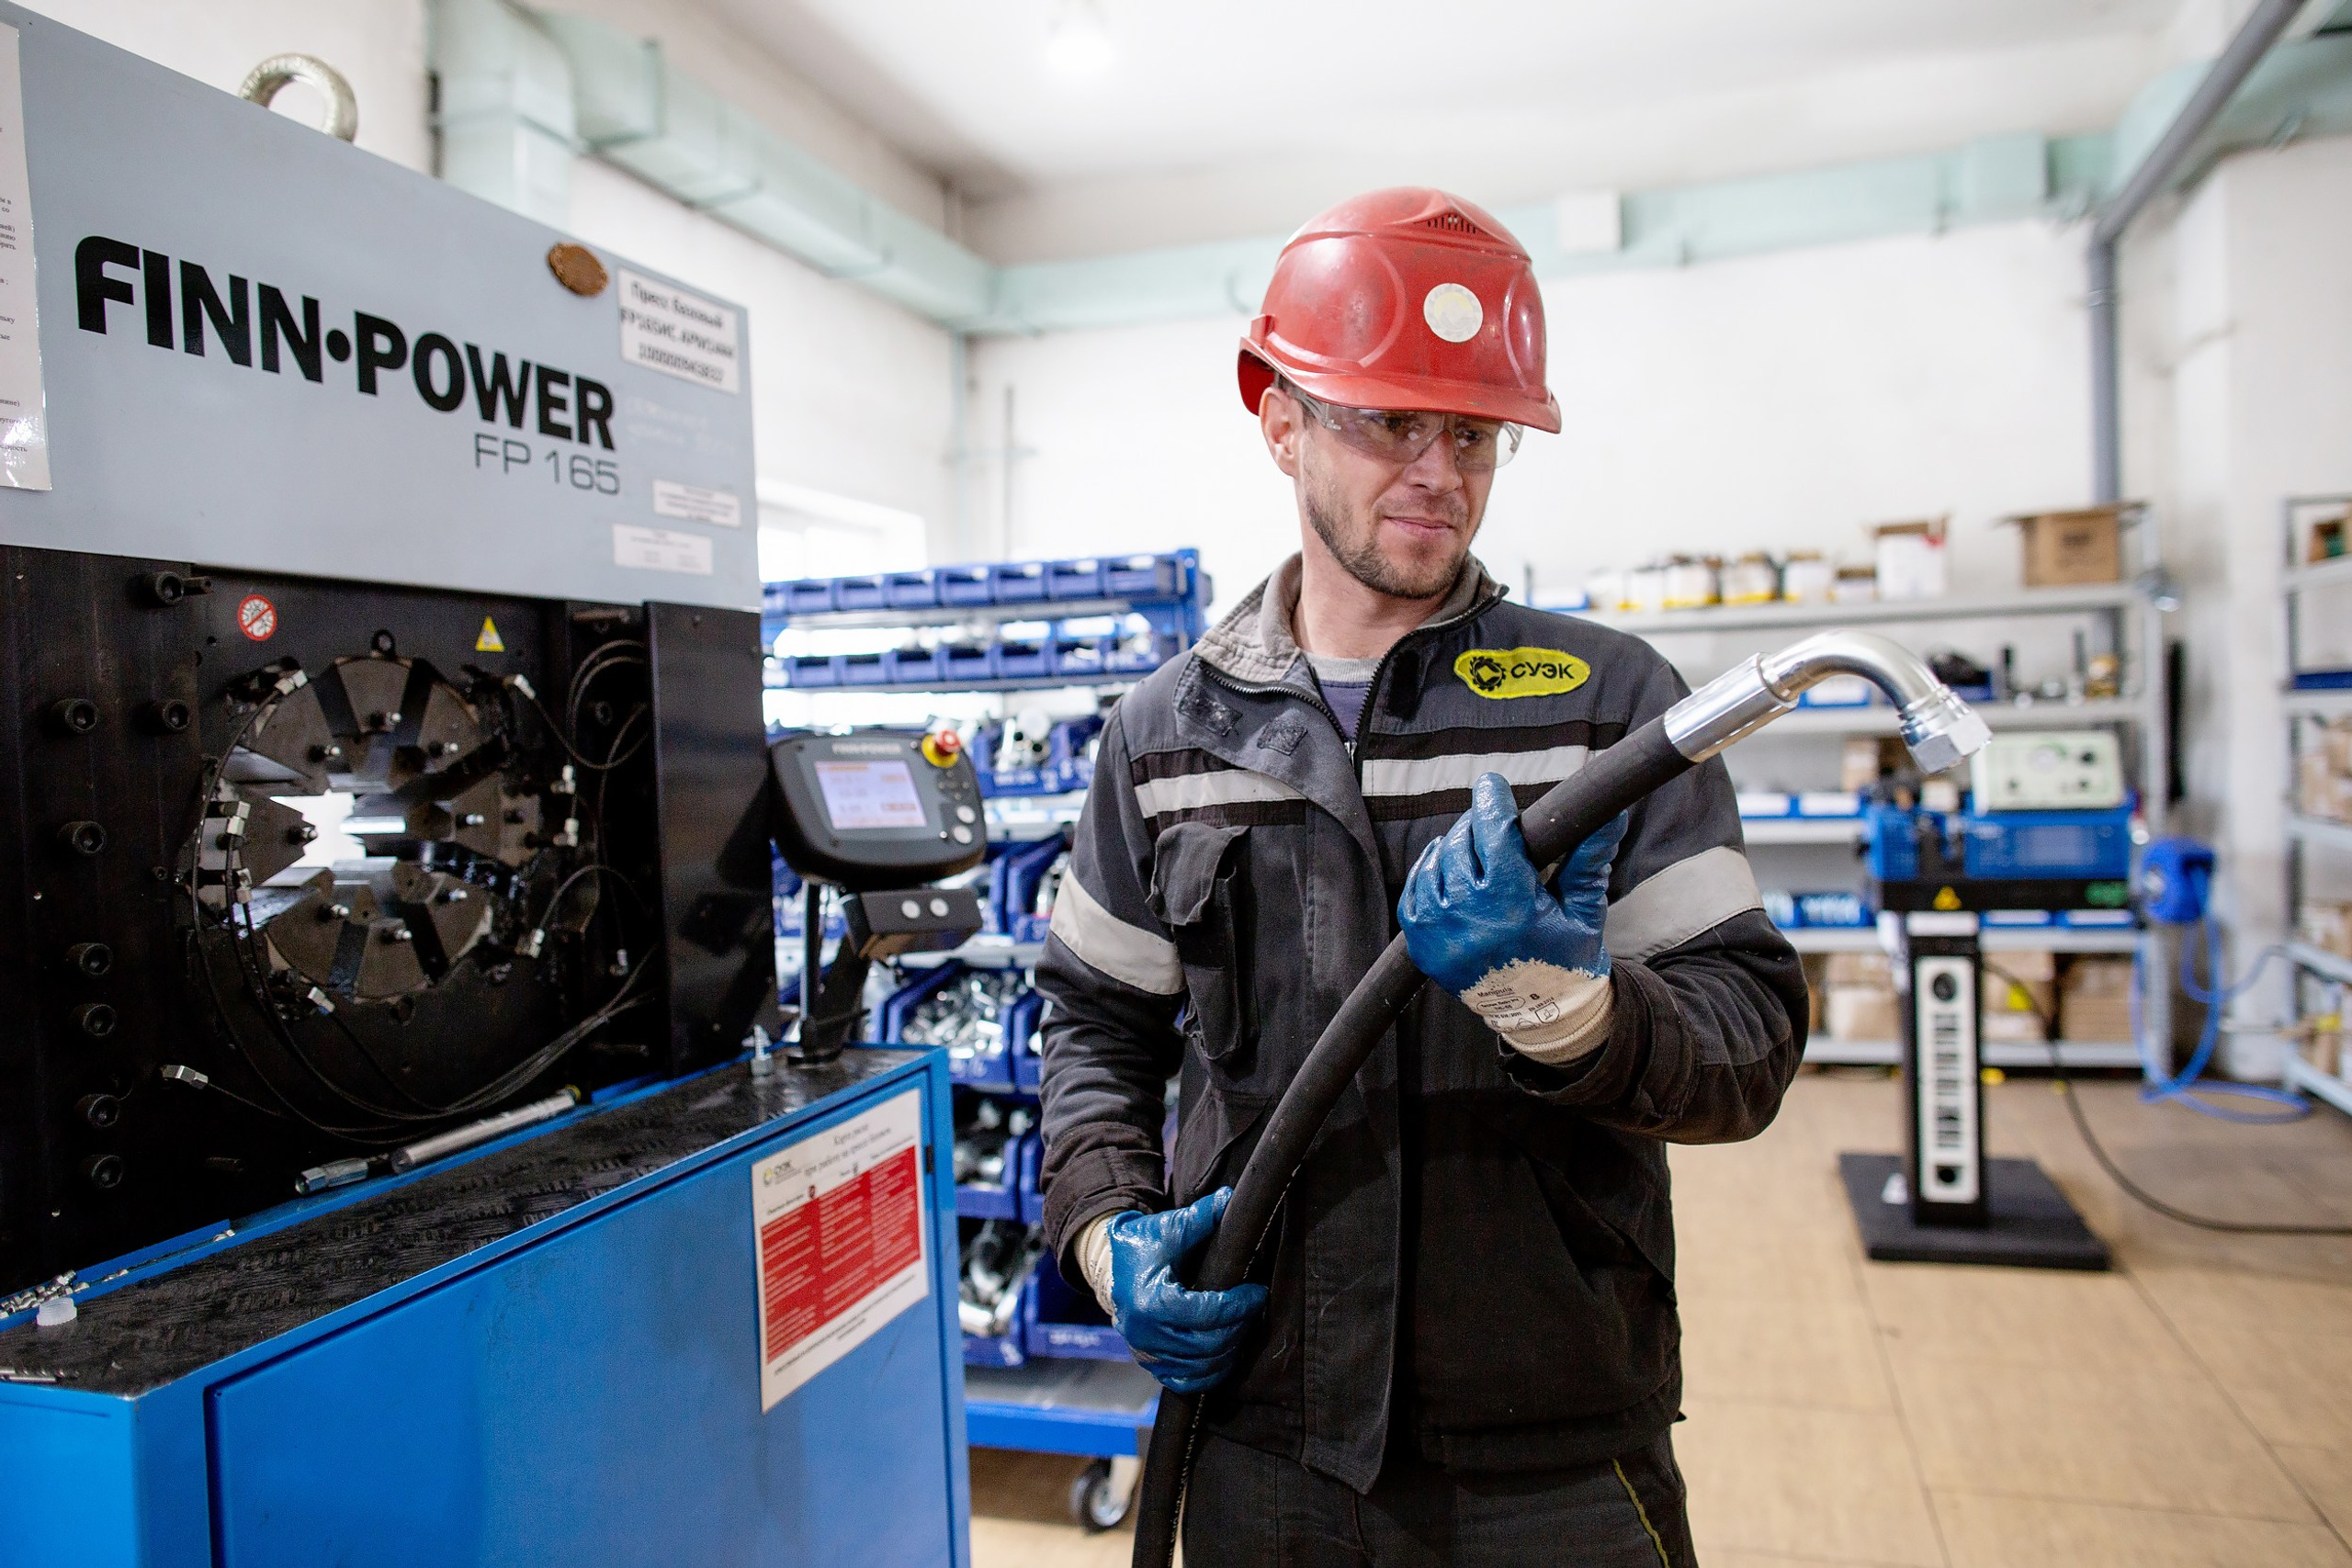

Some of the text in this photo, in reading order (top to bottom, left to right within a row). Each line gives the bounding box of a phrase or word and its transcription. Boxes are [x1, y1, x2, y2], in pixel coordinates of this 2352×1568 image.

[474, 433, 620, 496] FP 165
[1511, 661, 1575, 679] СУЭК
